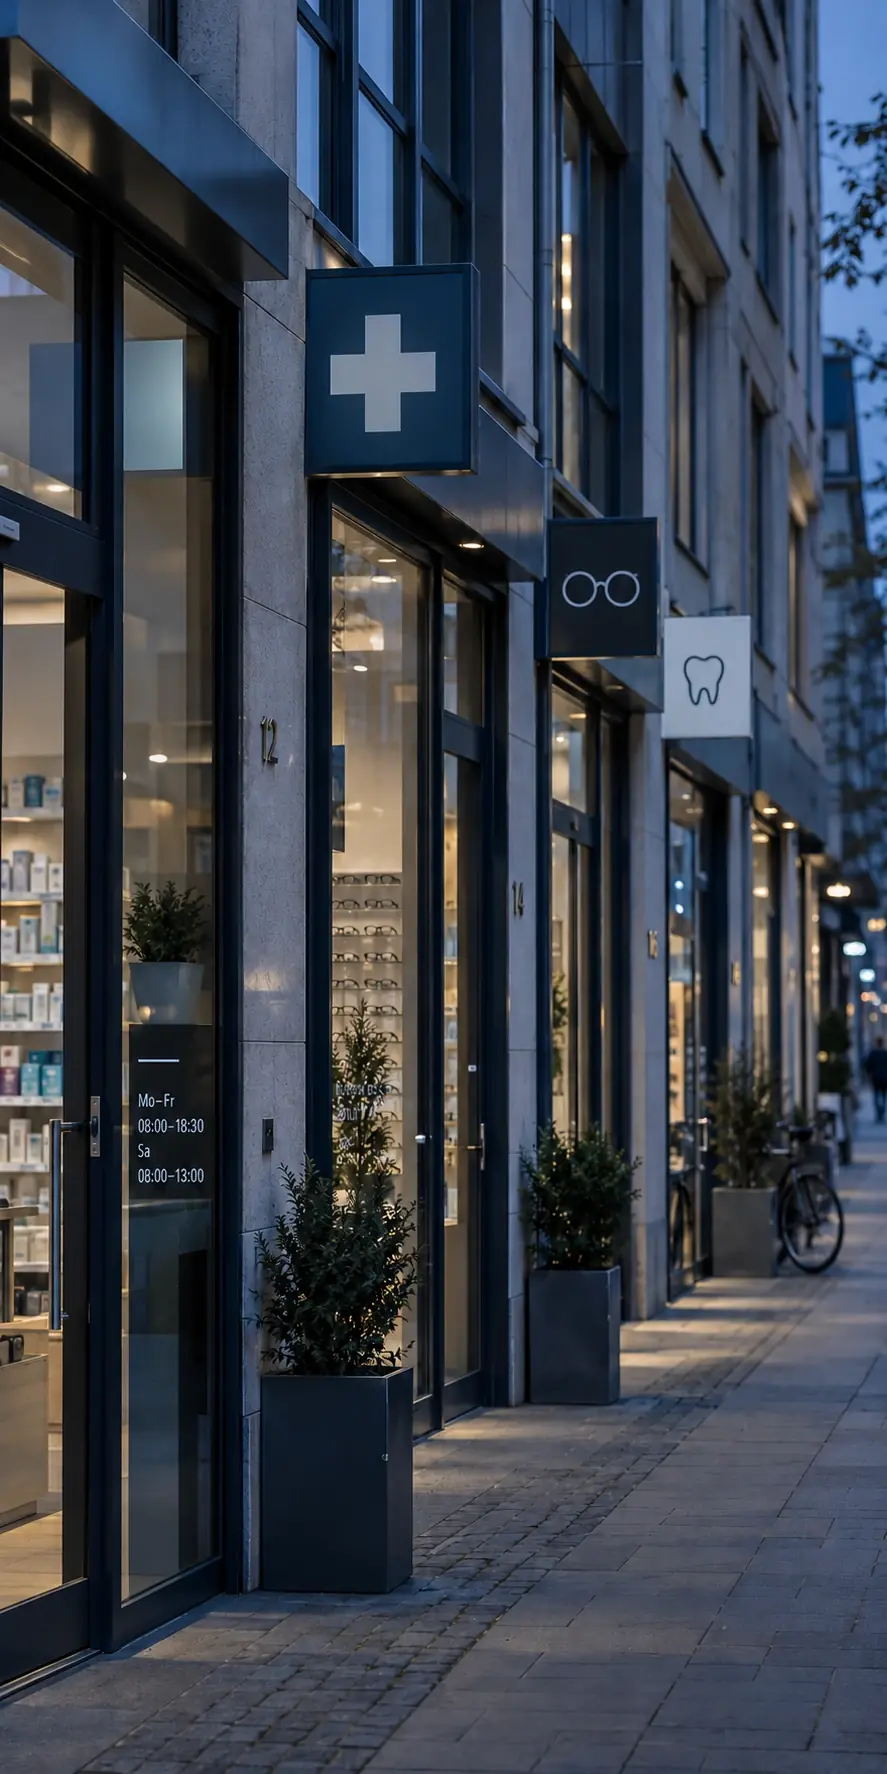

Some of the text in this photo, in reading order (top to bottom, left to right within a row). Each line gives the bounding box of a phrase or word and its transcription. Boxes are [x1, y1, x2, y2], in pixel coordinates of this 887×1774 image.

[260, 716, 278, 764] 12
[138, 1093, 175, 1108] Mo–Fr
[138, 1118, 204, 1133] 08:00–18:30
[138, 1143, 150, 1158] Sa
[138, 1168, 204, 1183] 08:00–13:00
